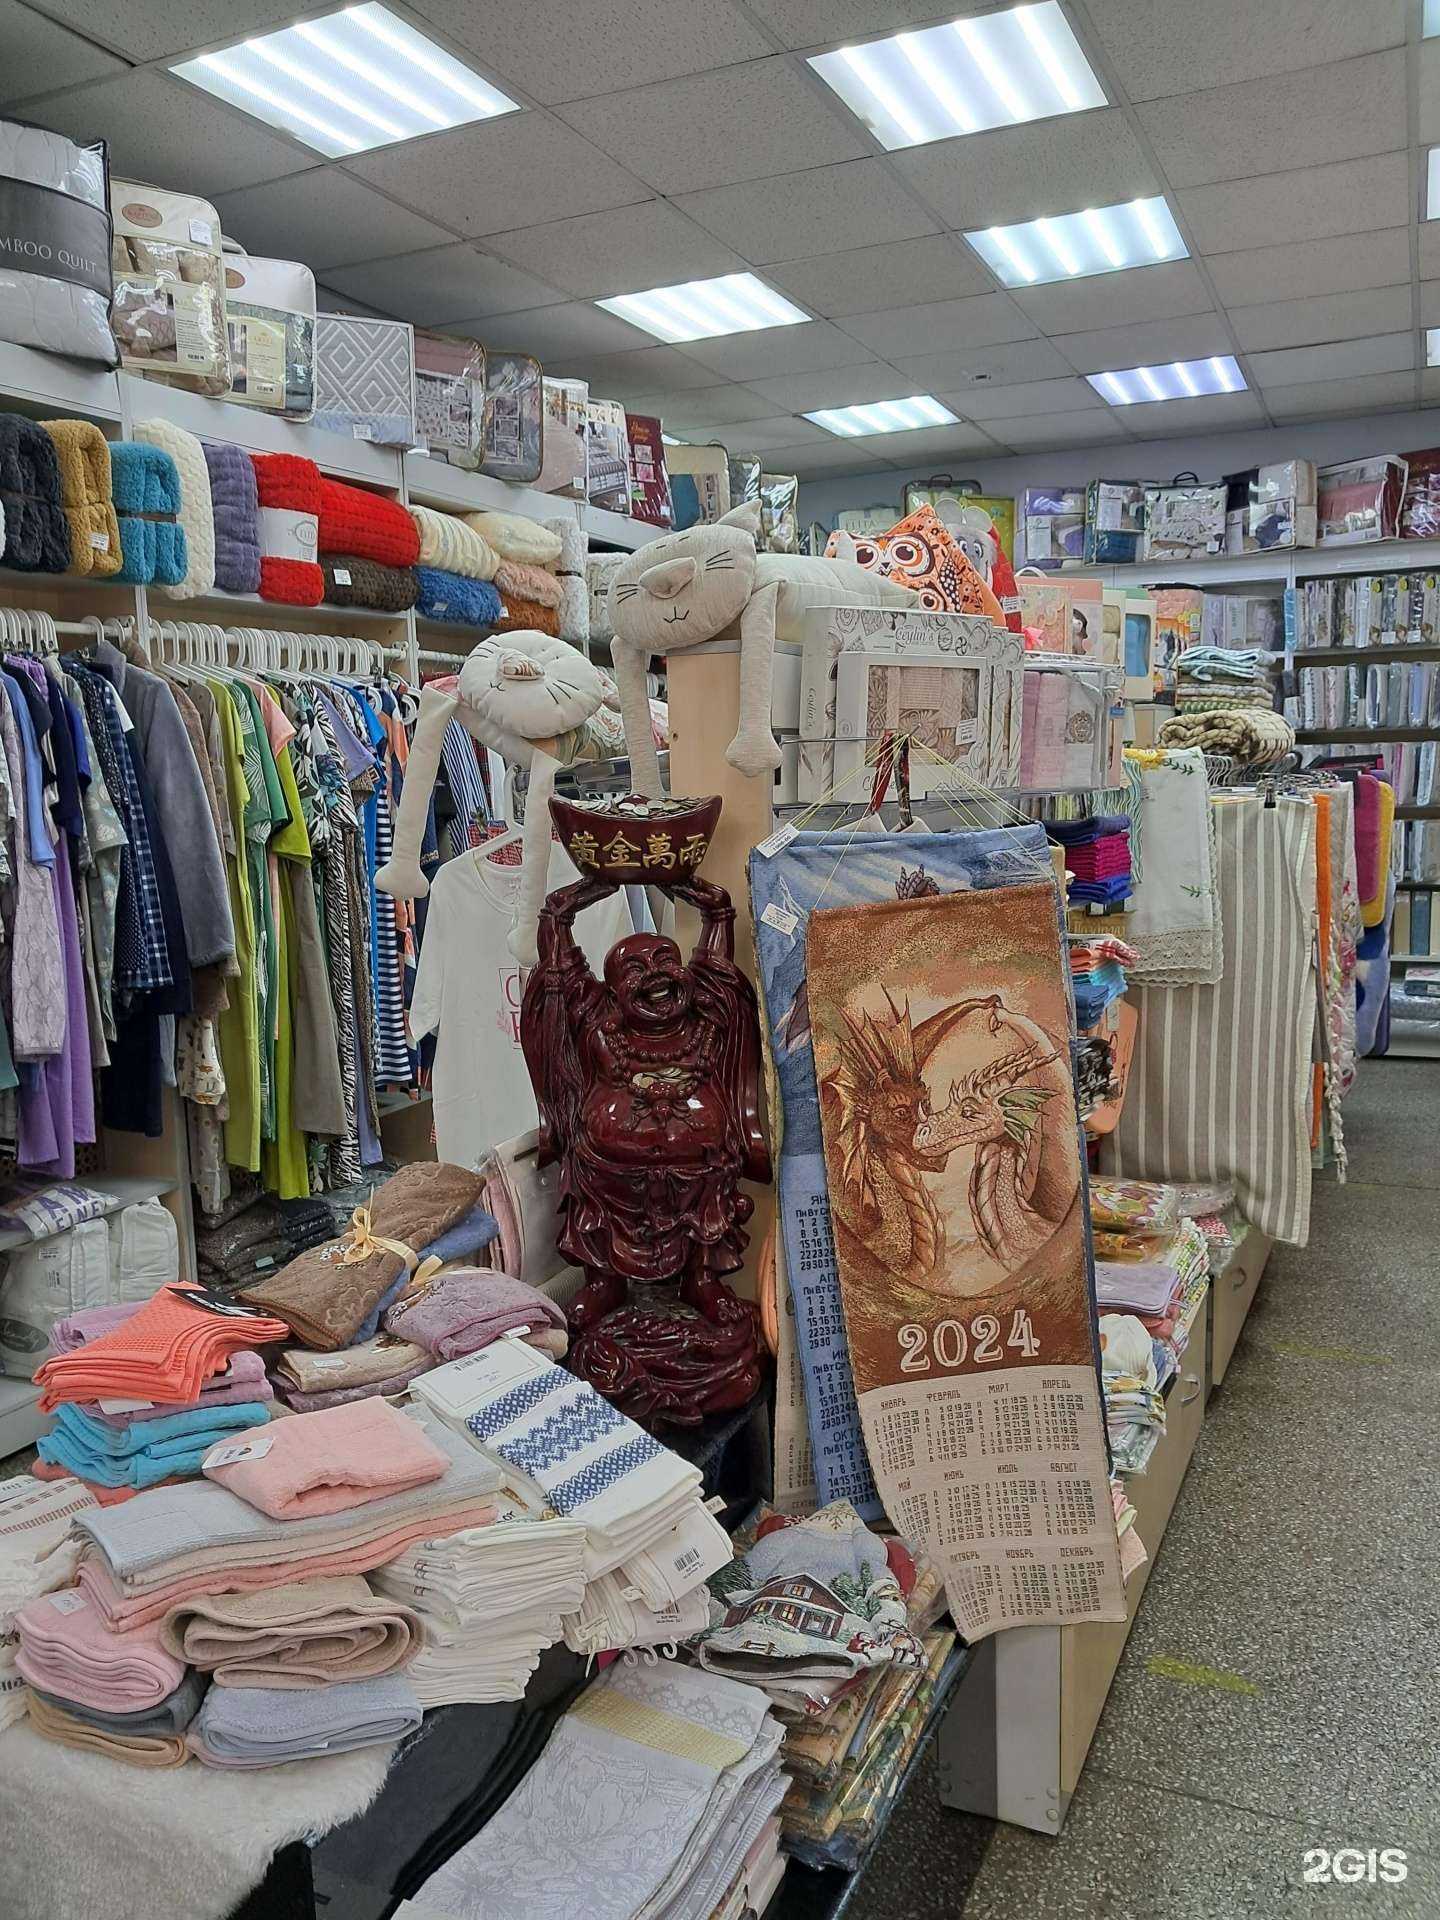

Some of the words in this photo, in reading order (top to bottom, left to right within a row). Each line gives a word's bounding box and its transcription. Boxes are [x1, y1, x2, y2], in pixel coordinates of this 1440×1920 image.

[57, 250, 97, 273] QUILT
[800, 1240, 810, 1248] 15
[811, 1239, 821, 1247] 16
[823, 1237, 834, 1246] 17
[800, 1251, 810, 1260] 22
[812, 1250, 823, 1258] 23
[824, 1249, 835, 1257] 24
[800, 1262, 811, 1270] 29
[812, 1260, 823, 1269] 30
[824, 1259, 835, 1267] 31
[807, 1317, 817, 1327] 15
[819, 1316, 829, 1325] 16
[831, 1315, 840, 1324] 17
[809, 1328, 819, 1338] 22
[819, 1327, 830, 1335] 23
[831, 1326, 842, 1335] 24
[809, 1339, 819, 1349] 29
[820, 1337, 830, 1347] 30
[897, 1309, 1040, 1373] 2024
[819, 1397, 828, 1407] 15
[829, 1394, 838, 1404] 16
[839, 1392, 848, 1402] 17
